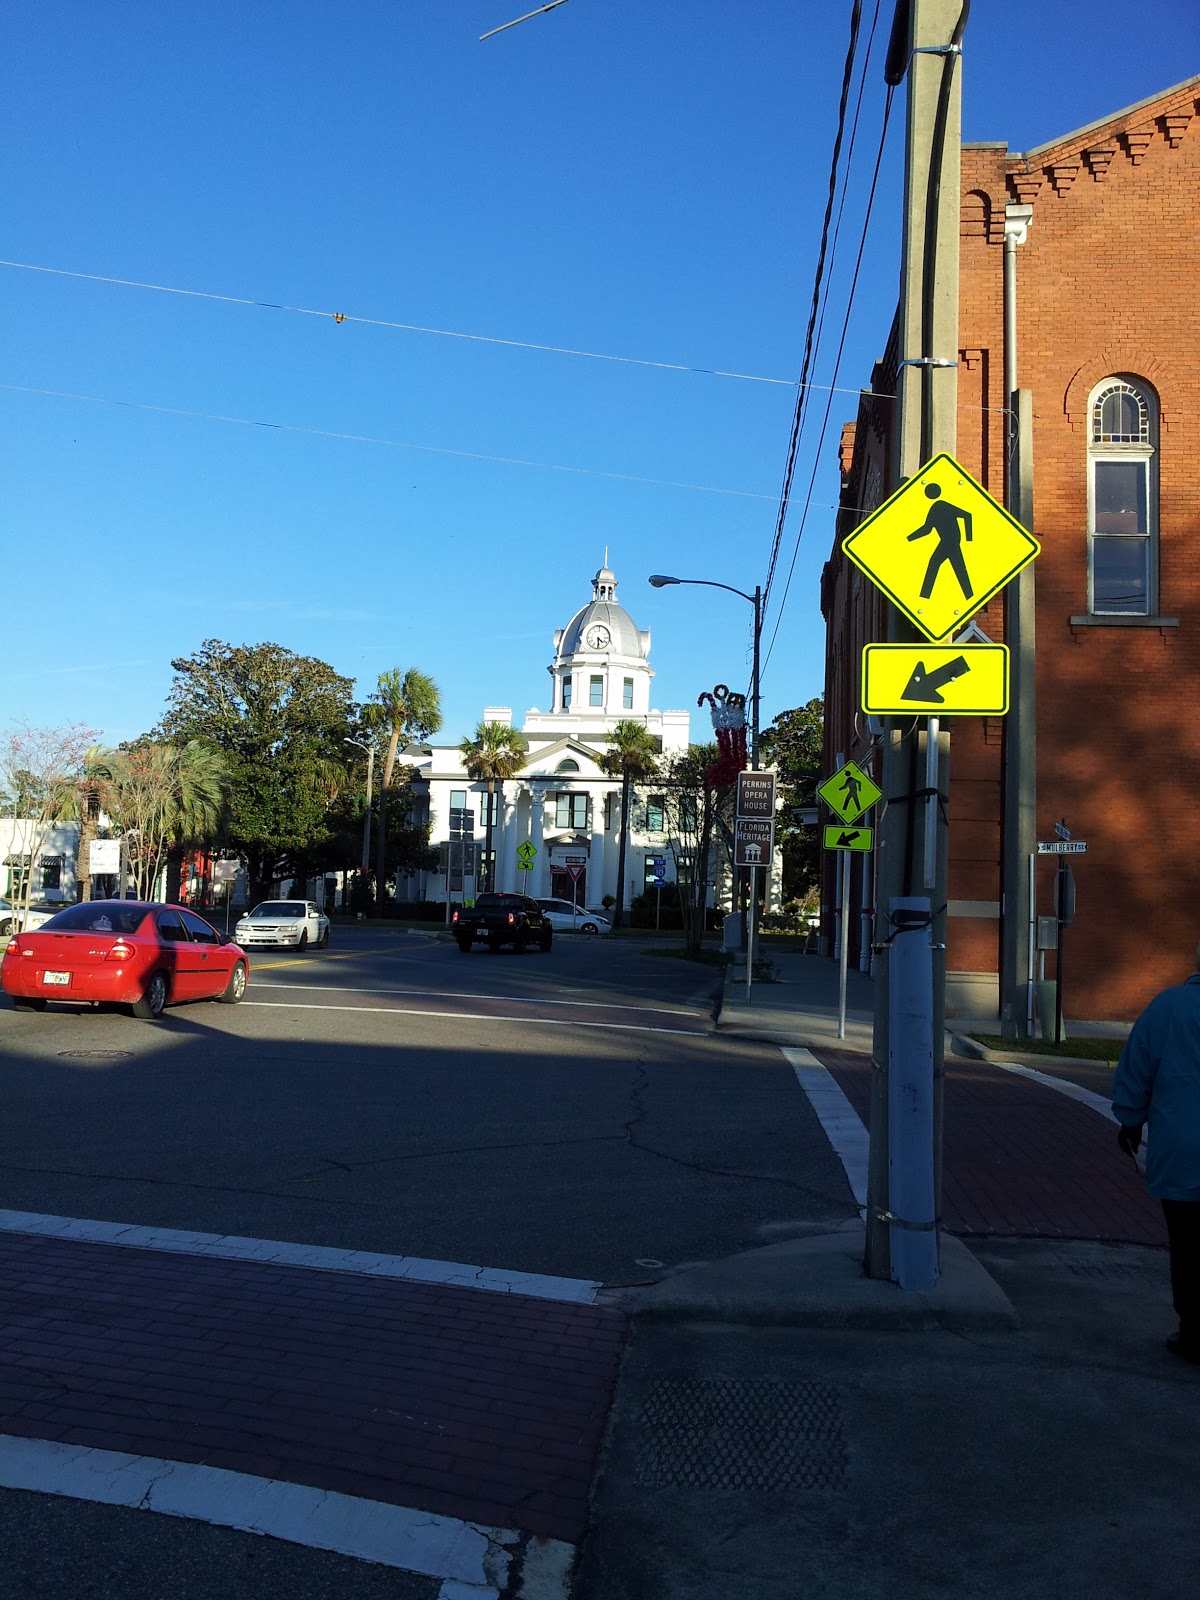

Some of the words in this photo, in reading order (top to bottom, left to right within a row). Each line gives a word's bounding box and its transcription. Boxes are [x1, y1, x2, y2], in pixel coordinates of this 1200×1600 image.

[742, 780, 772, 789] PERKINS
[744, 791, 767, 799] OPERA
[744, 802, 767, 810] HOUSE
[739, 822, 770, 832] FLORIDA
[737, 831, 771, 842] HERITAGE
[1046, 843, 1077, 852] MULBERRY
